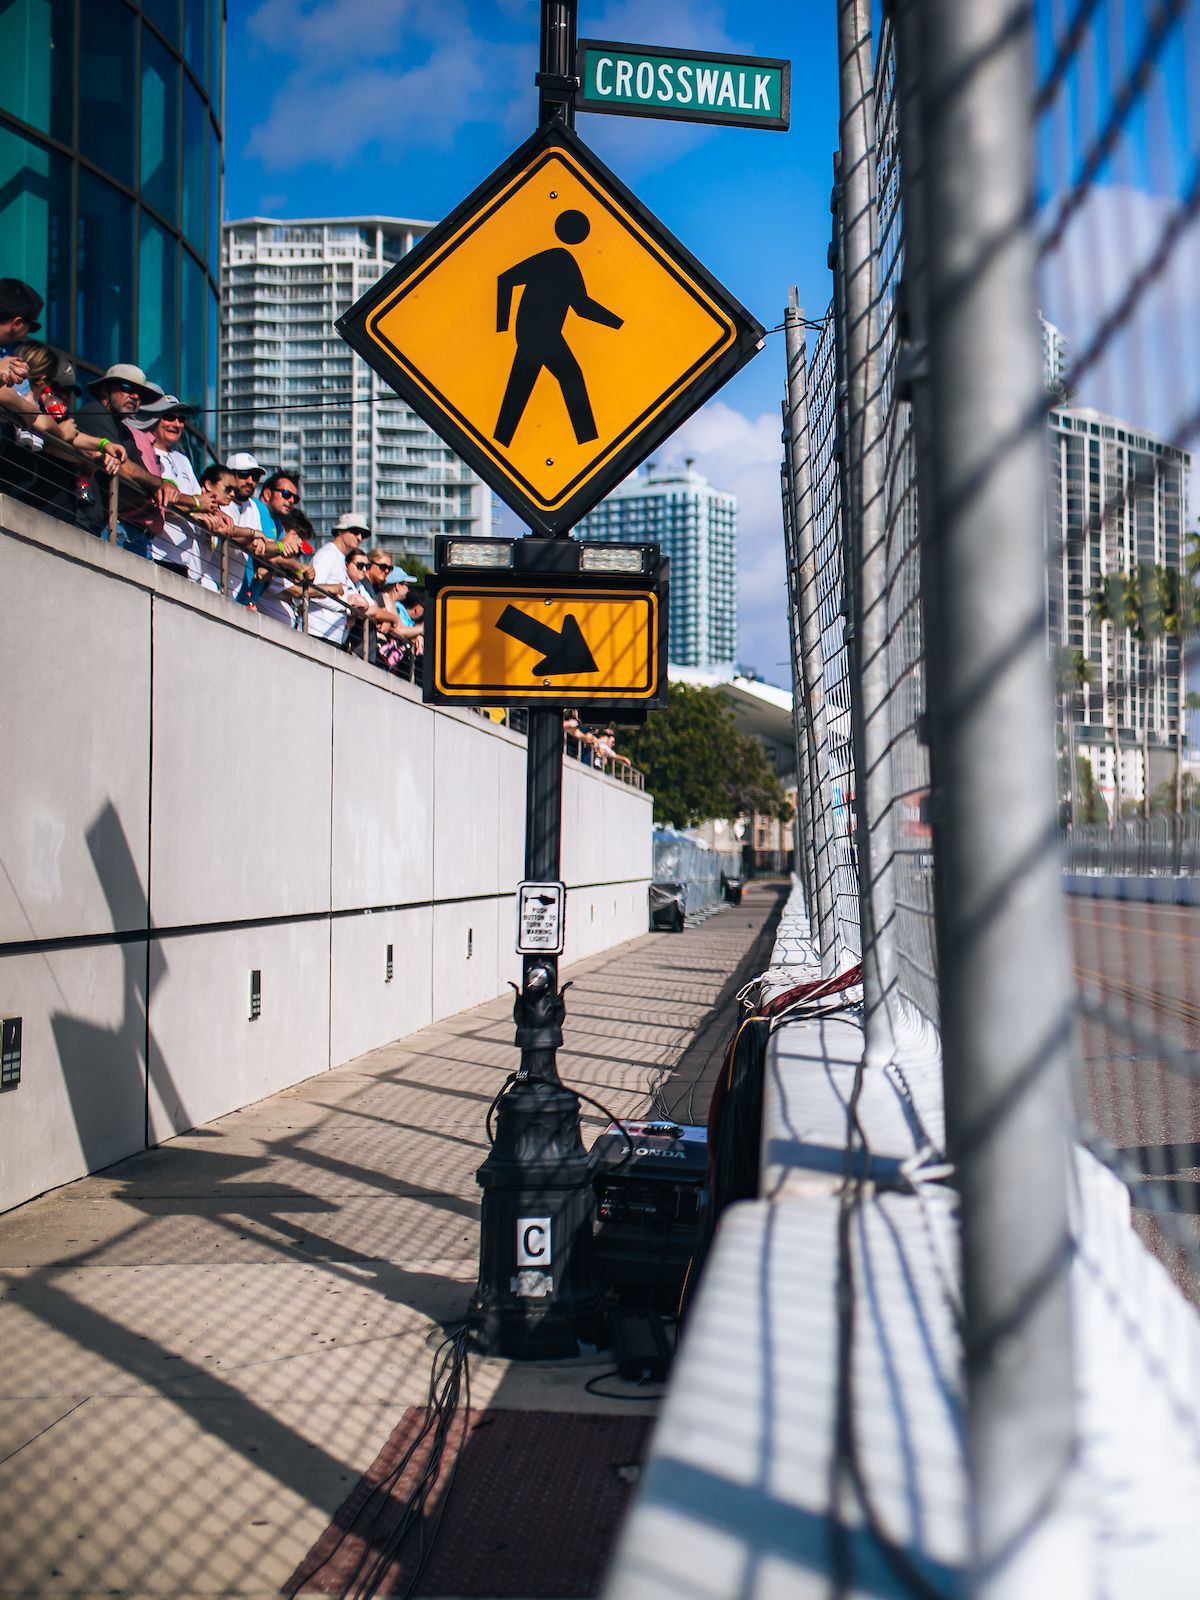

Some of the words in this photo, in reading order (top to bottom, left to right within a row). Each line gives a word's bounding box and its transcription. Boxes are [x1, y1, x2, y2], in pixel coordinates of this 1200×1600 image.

[596, 57, 771, 111] CROSSWALK
[526, 928, 553, 936] WARNING
[523, 1224, 545, 1257] C
